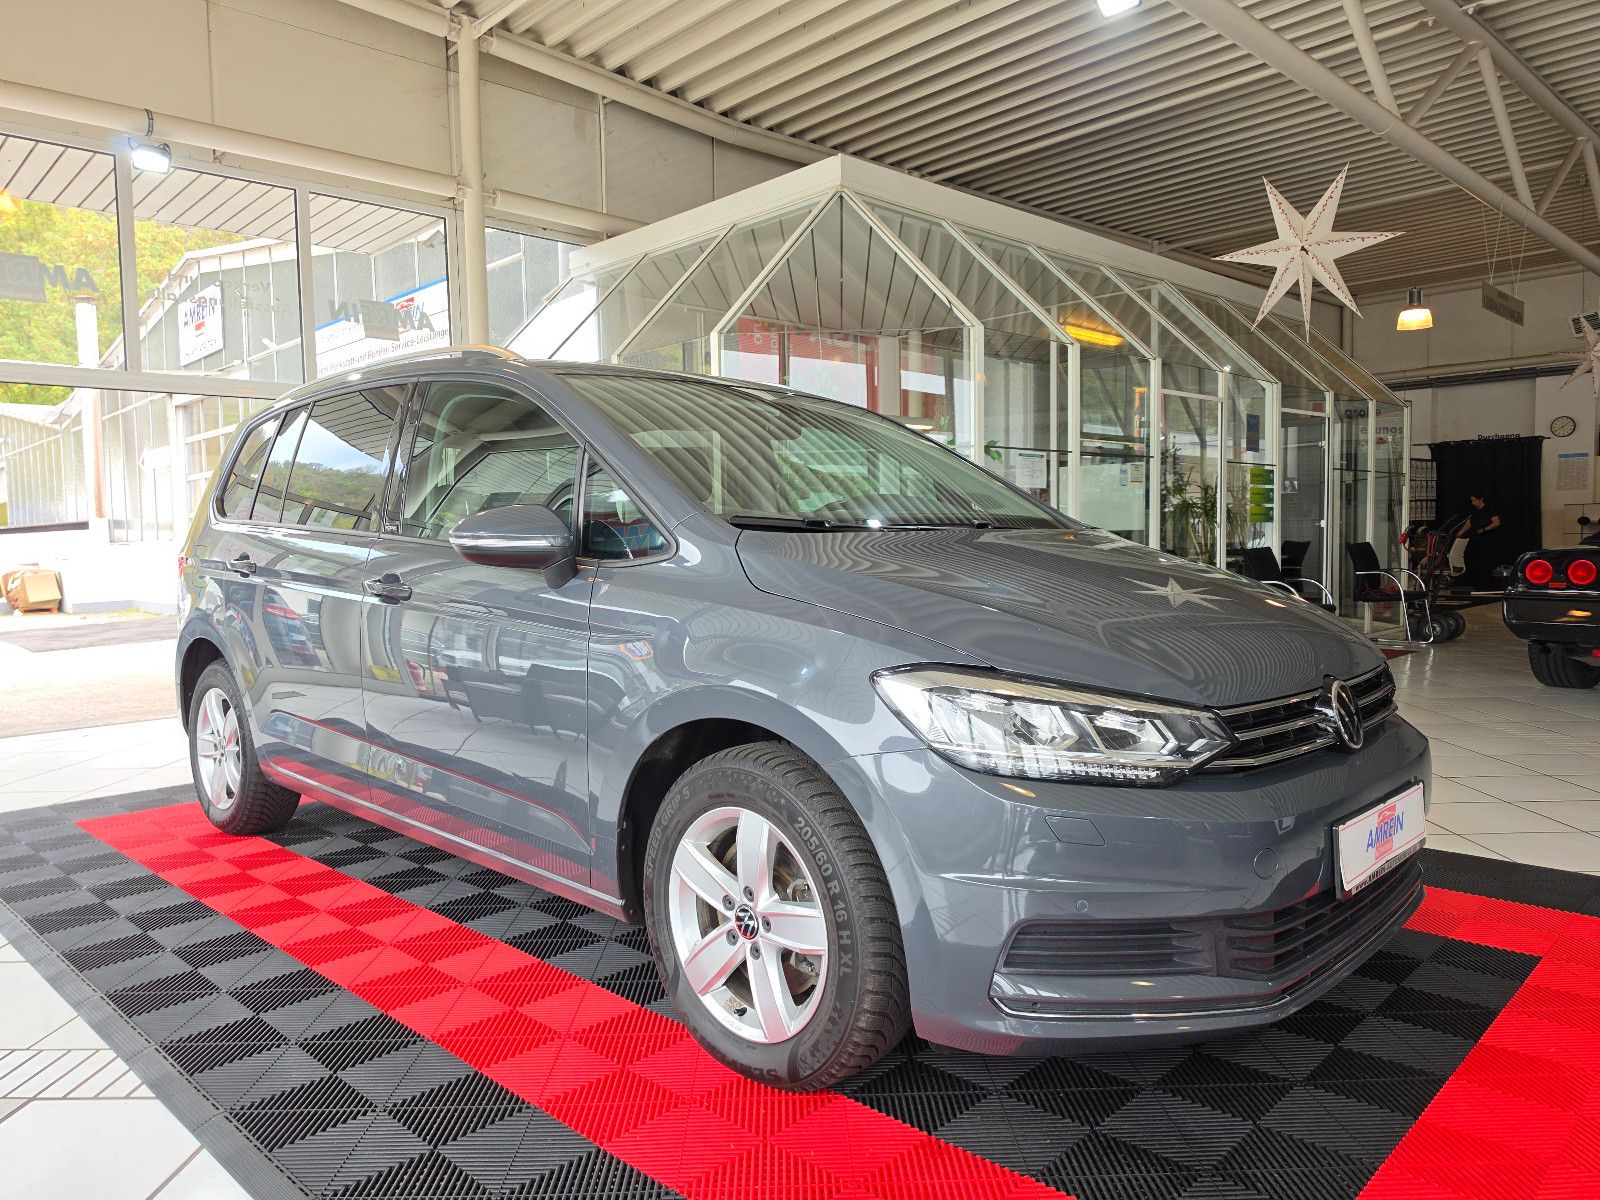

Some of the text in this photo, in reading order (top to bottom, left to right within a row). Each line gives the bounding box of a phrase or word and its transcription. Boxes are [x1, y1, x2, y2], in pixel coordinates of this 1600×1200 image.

[183, 296, 218, 328] AMREIN
[1365, 811, 1405, 853] AMREIN
[793, 816, 853, 976] 205/60 R 16 H XL
